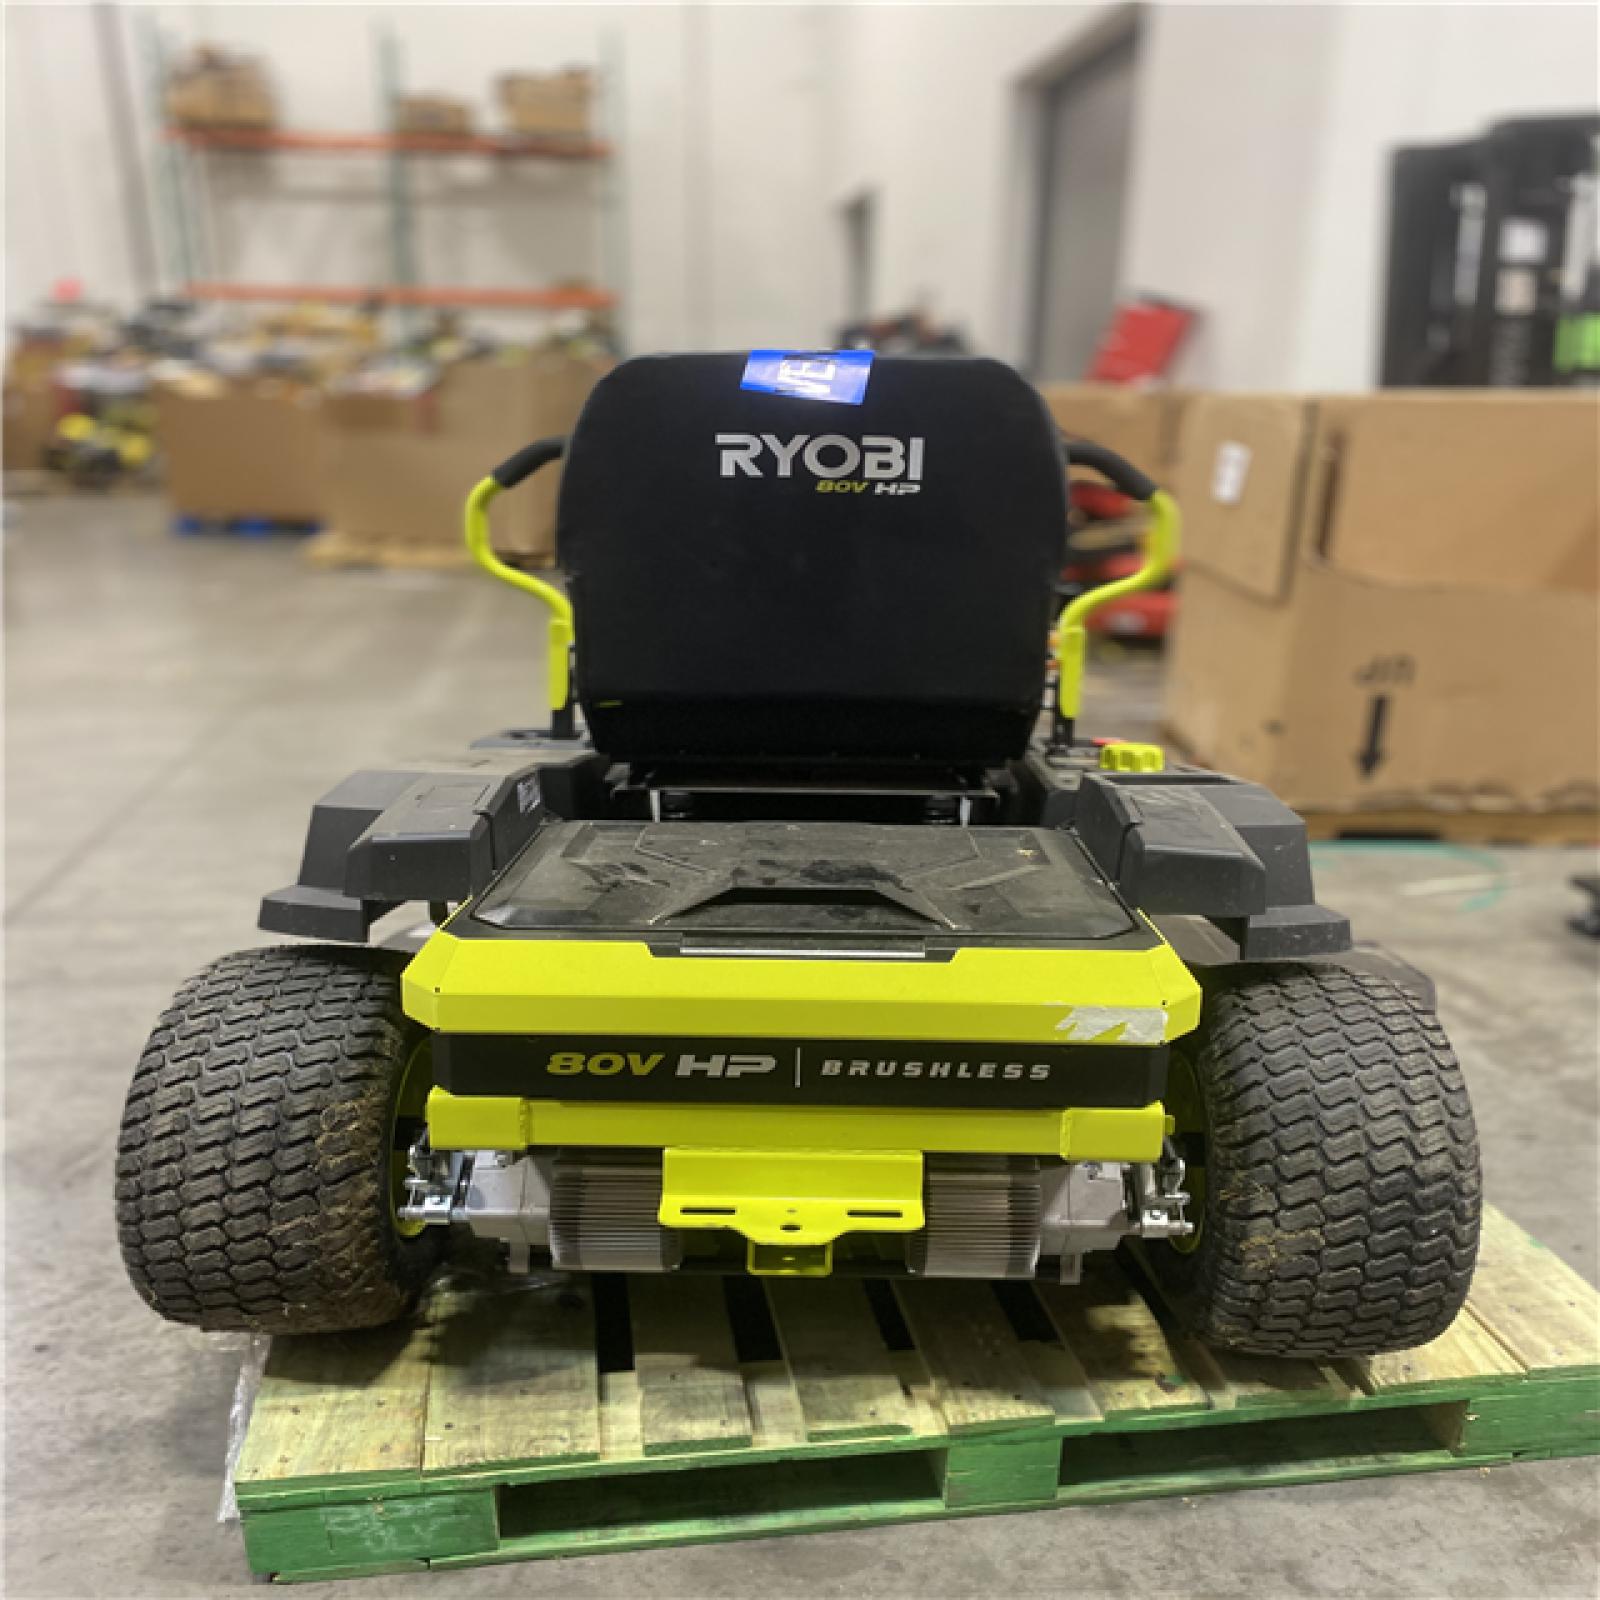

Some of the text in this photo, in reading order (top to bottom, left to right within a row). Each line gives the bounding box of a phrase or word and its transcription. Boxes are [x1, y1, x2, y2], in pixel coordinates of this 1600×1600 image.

[715, 433, 924, 480] RYOBI
[816, 480, 921, 495] 80V HP
[547, 1052, 1051, 1080] 80V HP BRUSHLESS
